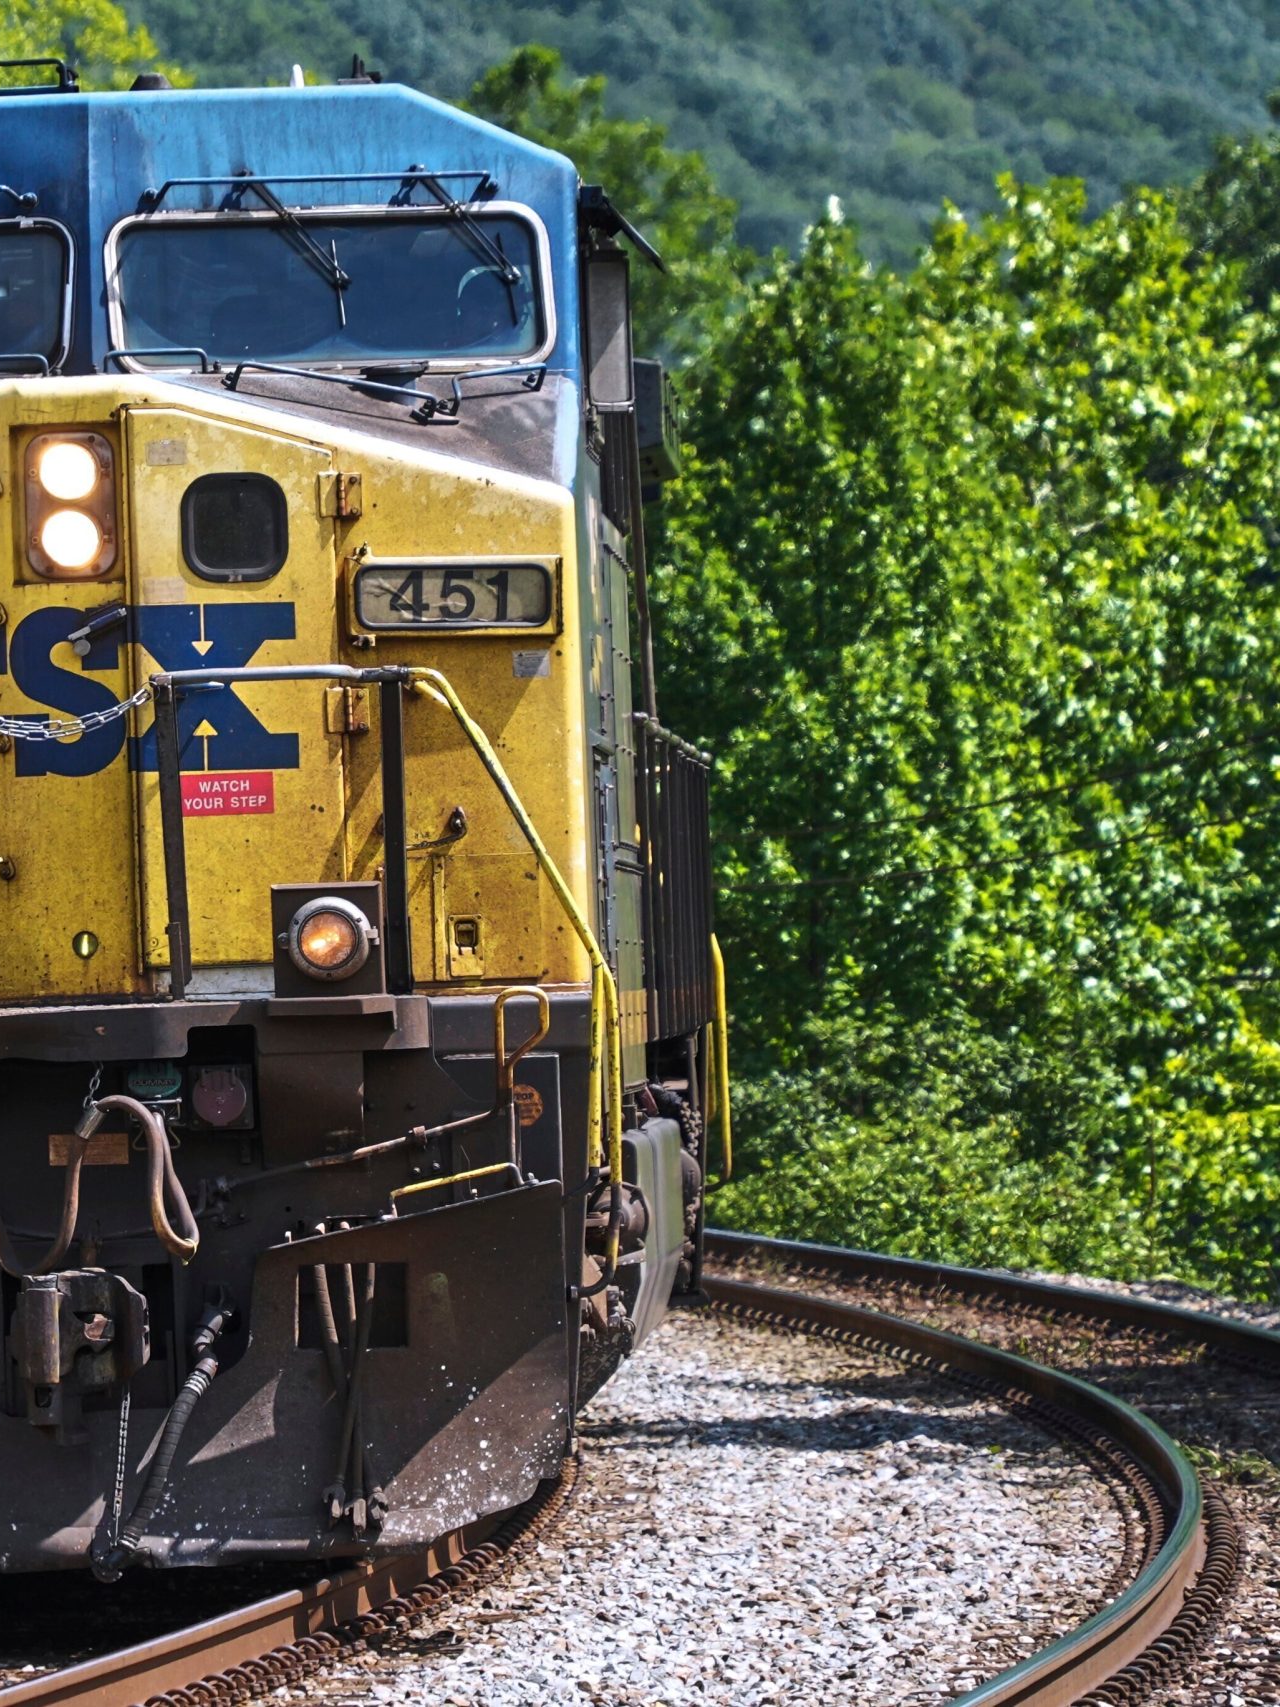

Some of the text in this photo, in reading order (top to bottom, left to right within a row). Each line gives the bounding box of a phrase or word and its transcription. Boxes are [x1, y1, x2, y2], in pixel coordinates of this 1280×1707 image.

[389, 570, 509, 623] 451
[199, 779, 250, 793] WATCH
[184, 795, 267, 810] YOUR STEP
